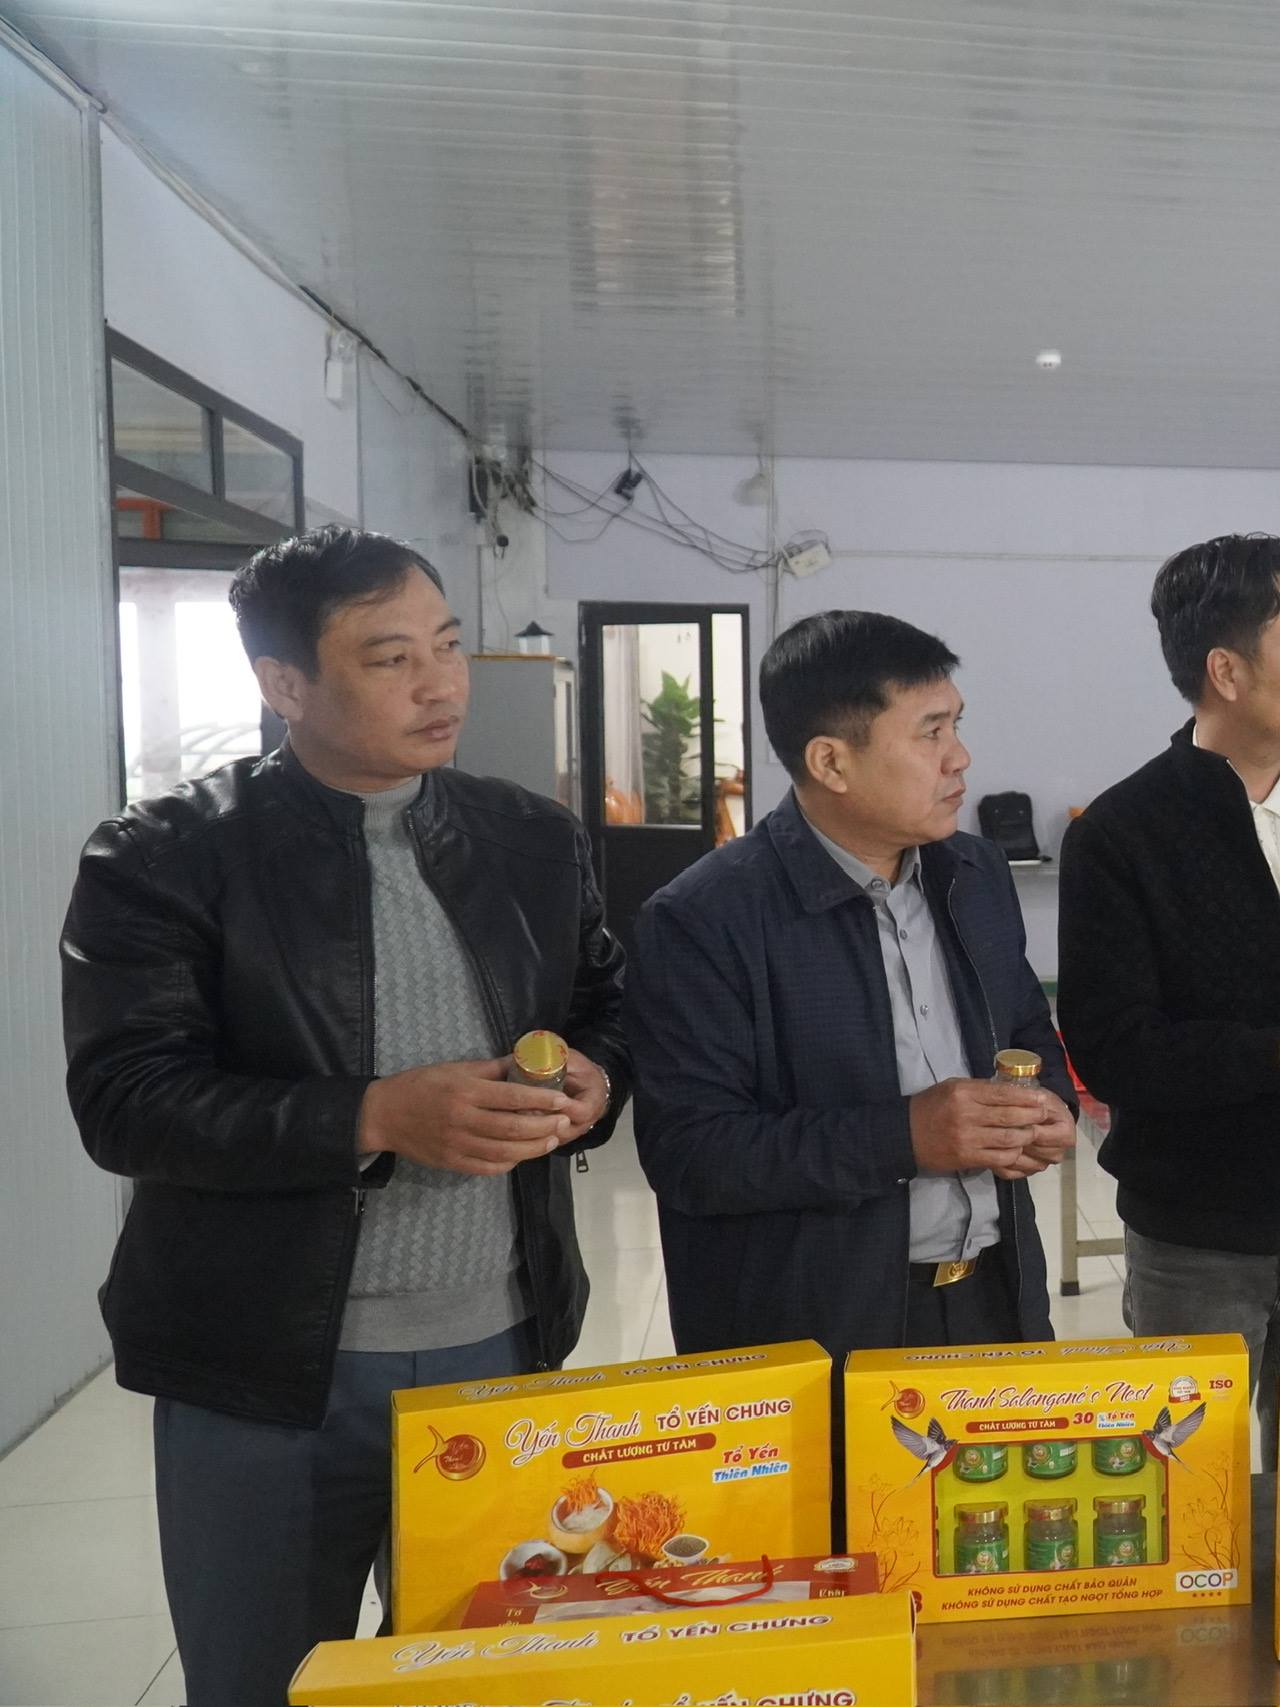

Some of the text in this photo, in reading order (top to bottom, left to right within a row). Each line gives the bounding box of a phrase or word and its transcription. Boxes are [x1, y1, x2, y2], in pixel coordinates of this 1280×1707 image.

[1209, 1379, 1233, 1390] ISO
[940, 1386, 997, 1411] Thanh
[1105, 1380, 1155, 1403] Nest
[1073, 1412, 1095, 1425] 30
[505, 1399, 793, 1466] Yến Thanh TỔ YẾN CHƯNG
[723, 1442, 779, 1464] Tổ Yến
[713, 1460, 789, 1483] Thiên Nhiên
[1179, 1573, 1234, 1589] OCOP
[968, 1585, 1005, 1597] KHÔNG
[941, 1599, 979, 1611] KHÔNG
[393, 1641, 477, 1673] Yến
[481, 1631, 601, 1660] Thanh
[727, 1613, 834, 1634] CHƯNG
